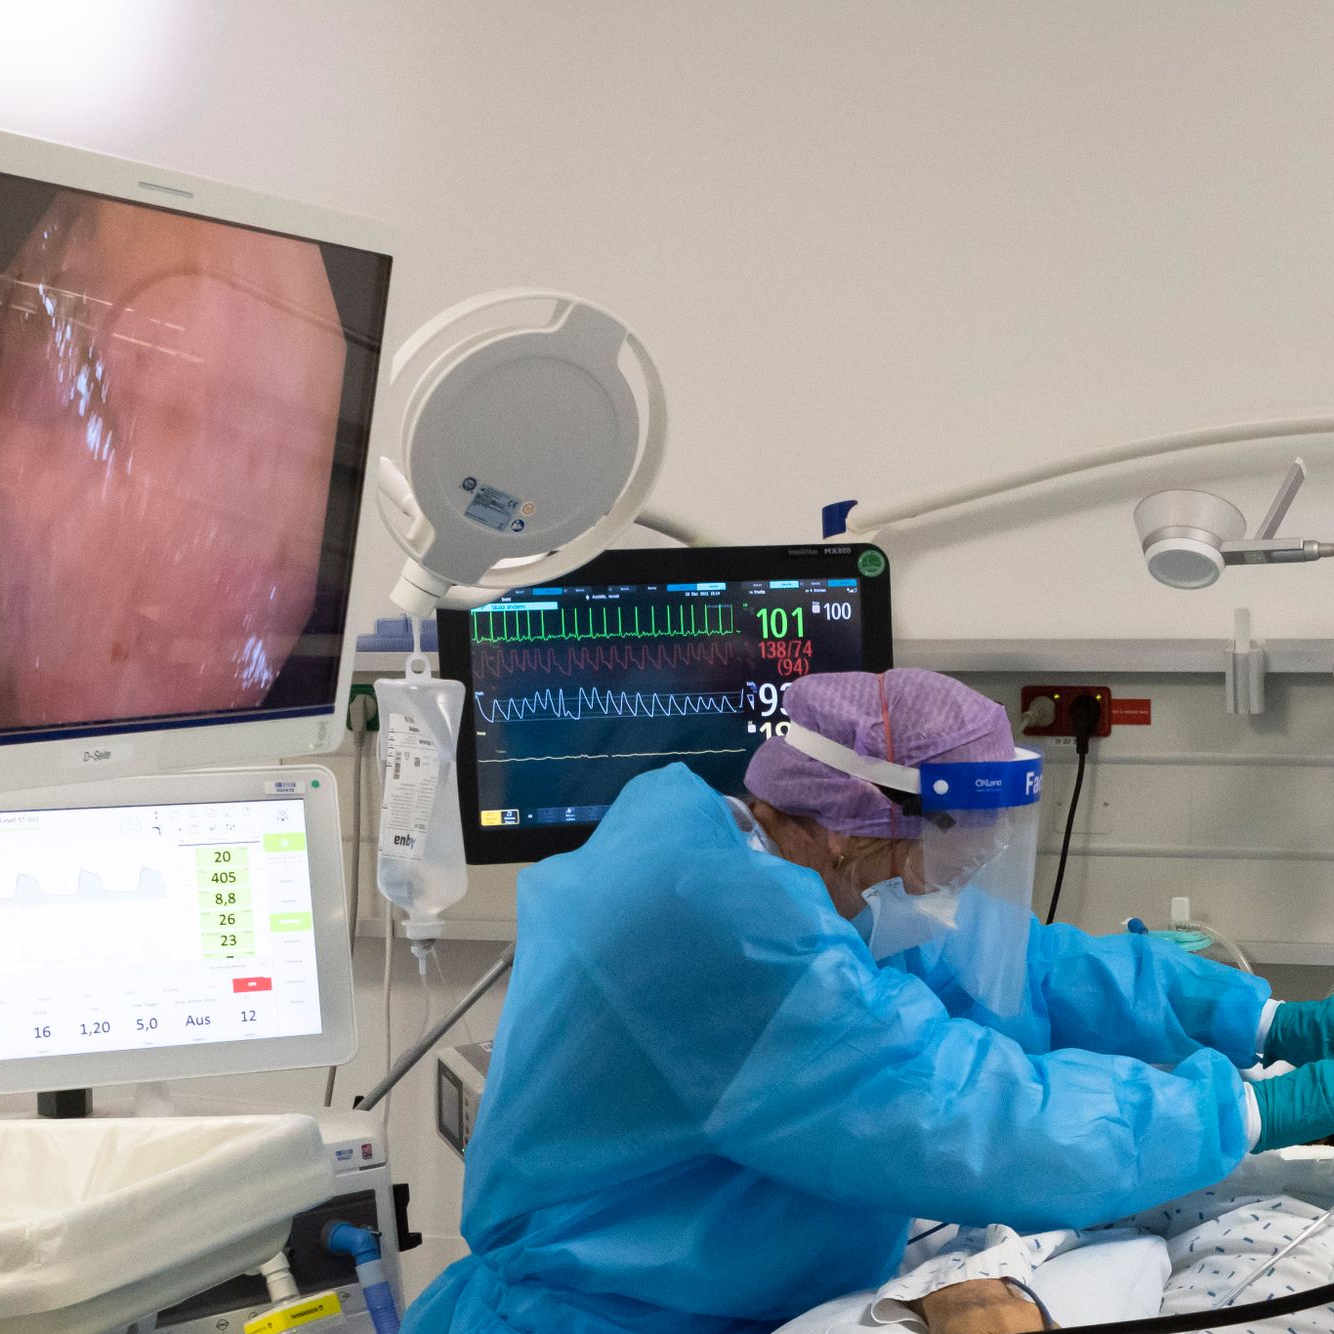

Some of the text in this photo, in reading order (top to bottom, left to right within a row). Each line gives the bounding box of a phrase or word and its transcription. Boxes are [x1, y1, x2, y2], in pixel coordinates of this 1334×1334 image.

[824, 602, 851, 620] 100
[757, 607, 804, 640] 101
[759, 639, 812, 659] 138/74
[777, 658, 810, 676] (94)
[214, 851, 231, 863] 20
[211, 872, 236, 884] 405
[215, 892, 236, 906] 8,8
[219, 914, 236, 926] 26
[220, 935, 237, 947] 23
[33, 1026, 52, 1039] 16
[80, 1021, 111, 1036] 1,20
[136, 1017, 158, 1031] 5,0
[185, 1014, 211, 1028] Aus
[240, 1010, 257, 1023] 12
